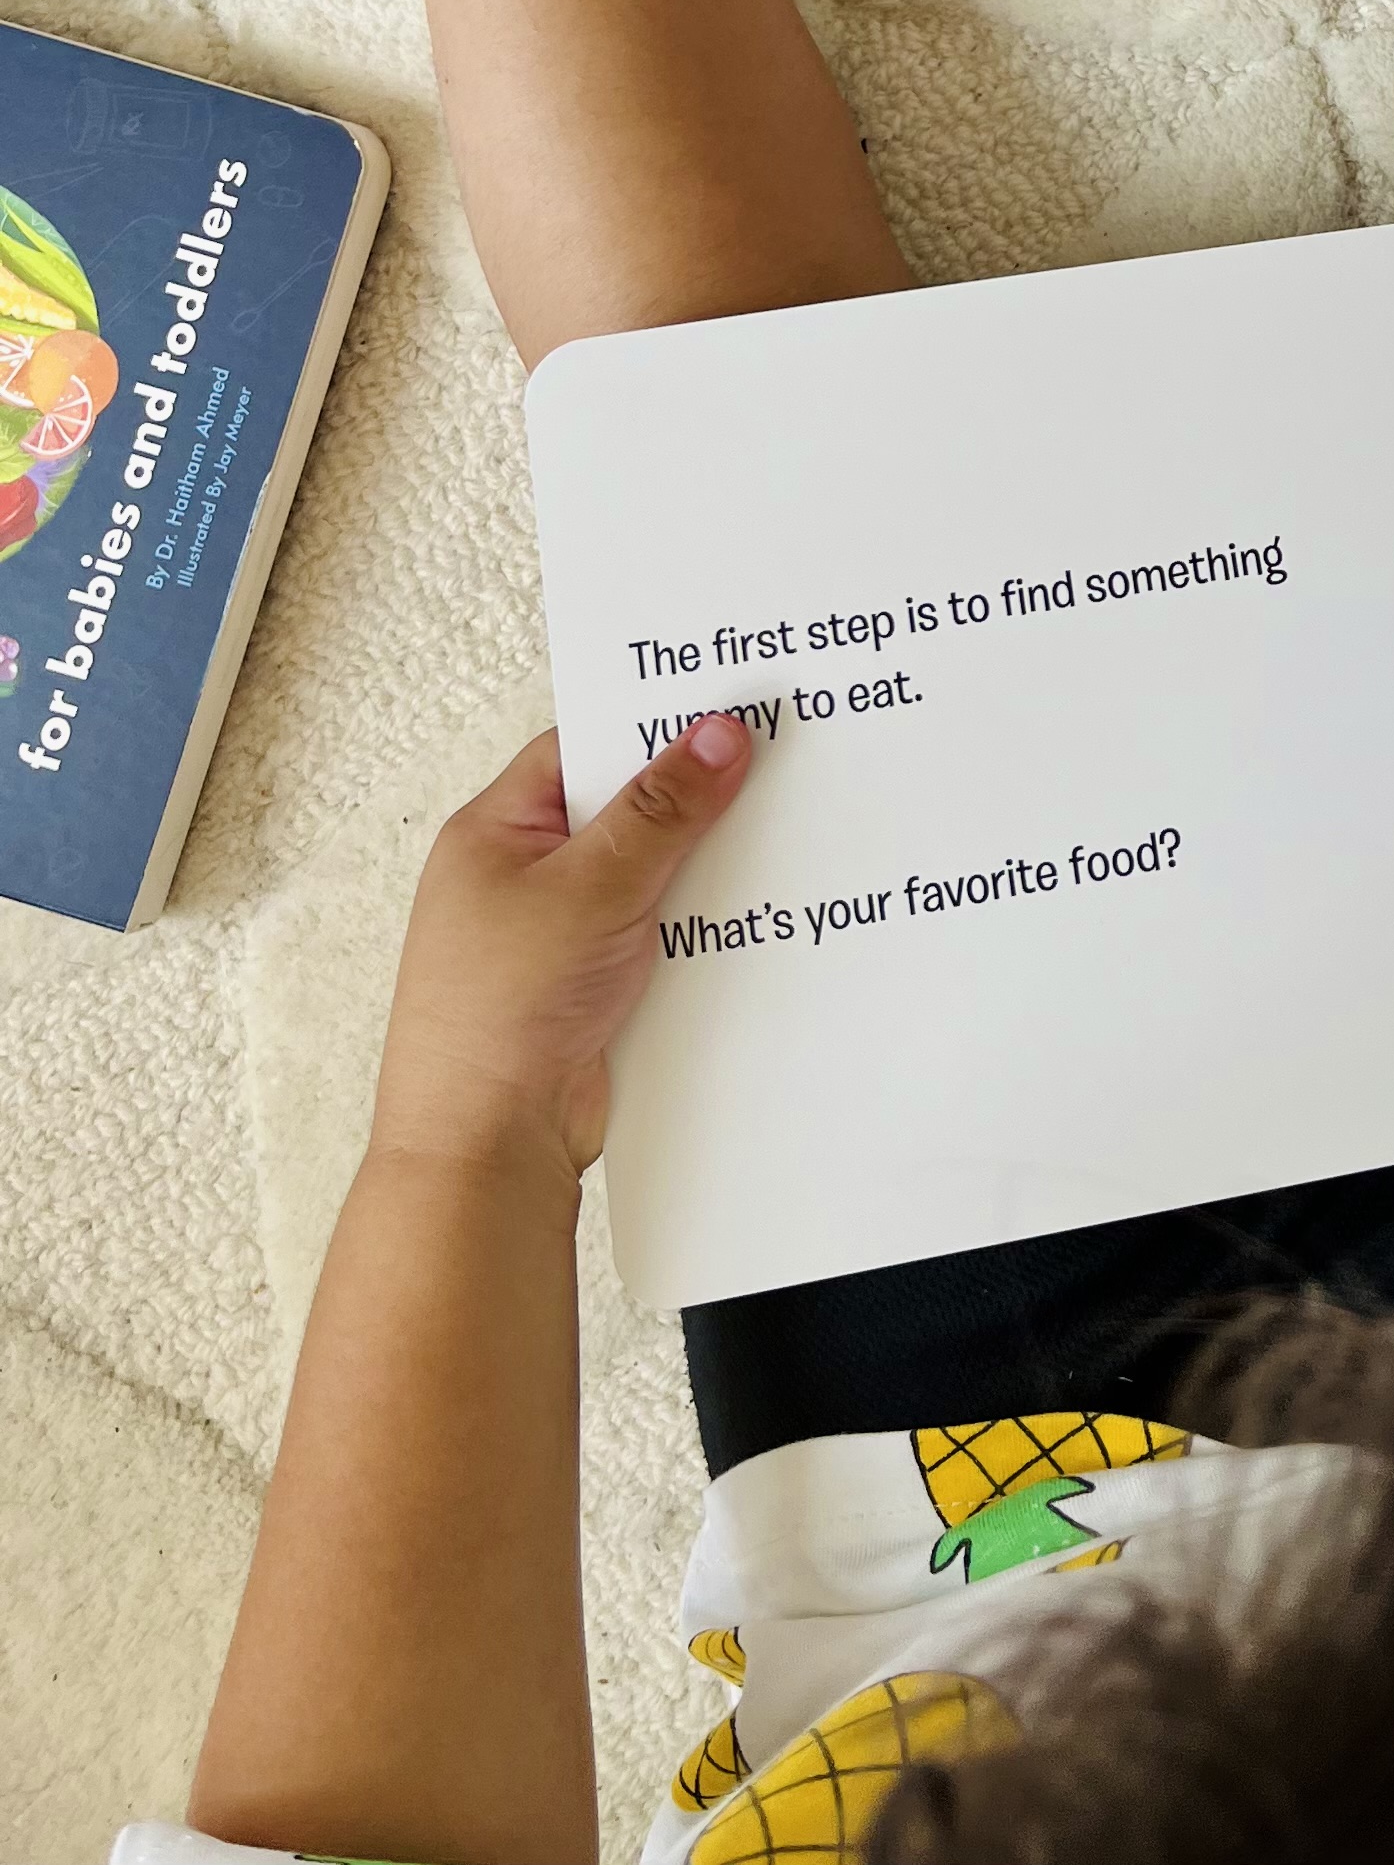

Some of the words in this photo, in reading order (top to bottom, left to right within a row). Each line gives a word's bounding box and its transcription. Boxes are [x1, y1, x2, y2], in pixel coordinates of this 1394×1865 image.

[151, 158, 248, 375] toddlers
[124, 382, 177, 489] and
[195, 366, 230, 439] Ahmed
[225, 386, 252, 441] Meyer
[166, 443, 207, 526] Haitham
[205, 476, 227, 497] By
[213, 443, 237, 474] Jay
[146, 561, 170, 590] By
[155, 534, 178, 560] Dr.
[177, 500, 217, 588] Illustrated
[45, 501, 141, 680] babies
[629, 639, 702, 681] The
[712, 620, 797, 666] first
[808, 610, 896, 652] step
[906, 597, 939, 634] is
[947, 590, 990, 627] to
[1001, 570, 1076, 618] find
[1086, 536, 1288, 603] something
[18, 689, 78, 771] for
[792, 687, 835, 721] to
[848, 671, 924, 713] eat.
[659, 899, 796, 960] What's
[805, 887, 893, 945] your
[904, 856, 1059, 915] favorite
[1068, 827, 1182, 885] food?
